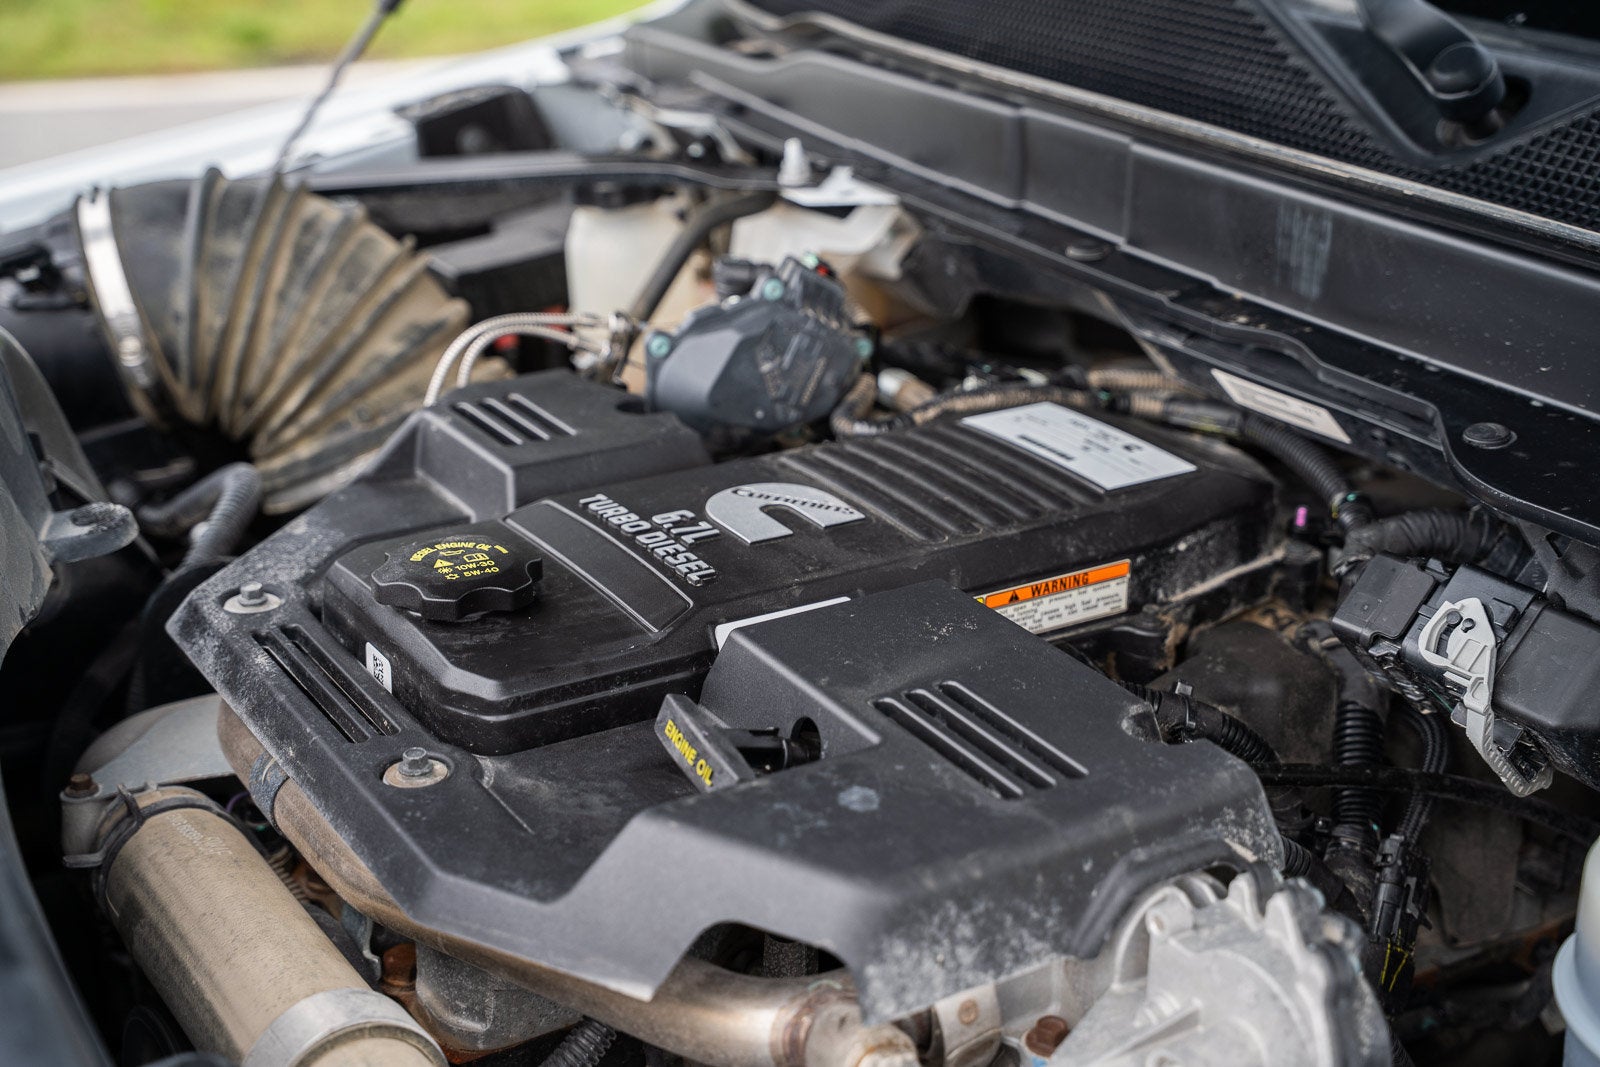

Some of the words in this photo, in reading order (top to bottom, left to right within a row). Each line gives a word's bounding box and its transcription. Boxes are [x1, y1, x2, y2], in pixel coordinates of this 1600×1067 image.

[731, 487, 854, 515] Cummins
[579, 493, 651, 536] TURBO
[635, 530, 718, 587] DIESEL
[651, 509, 719, 546] 6.7L
[434, 542, 476, 550] ENGINE
[454, 560, 495, 571] 10W-30
[463, 566, 499, 577] 5W-40
[1031, 573, 1089, 597] WARNING
[664, 719, 698, 766] ENGINE
[696, 759, 713, 786] OIL
